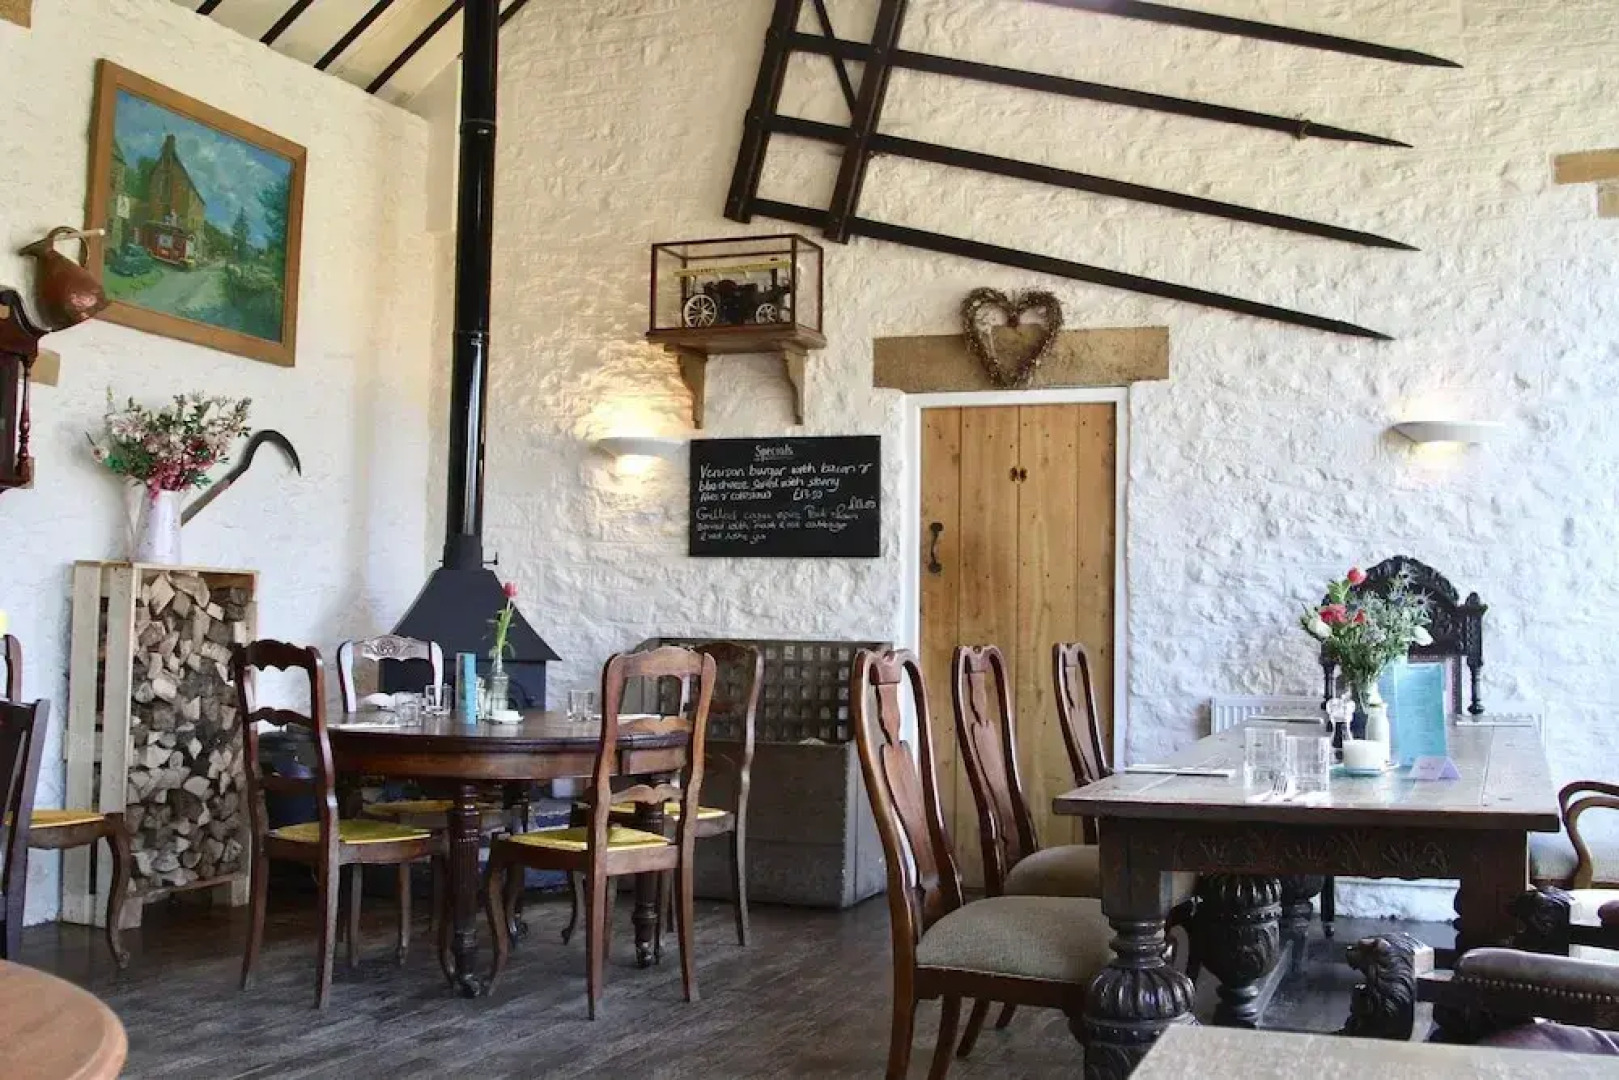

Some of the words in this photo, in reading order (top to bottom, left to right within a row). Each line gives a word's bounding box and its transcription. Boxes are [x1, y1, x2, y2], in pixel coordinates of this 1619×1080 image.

[754, 444, 794, 461] Specials
[700, 463, 745, 478] Venison
[791, 463, 817, 474] with
[780, 476, 804, 488] with
